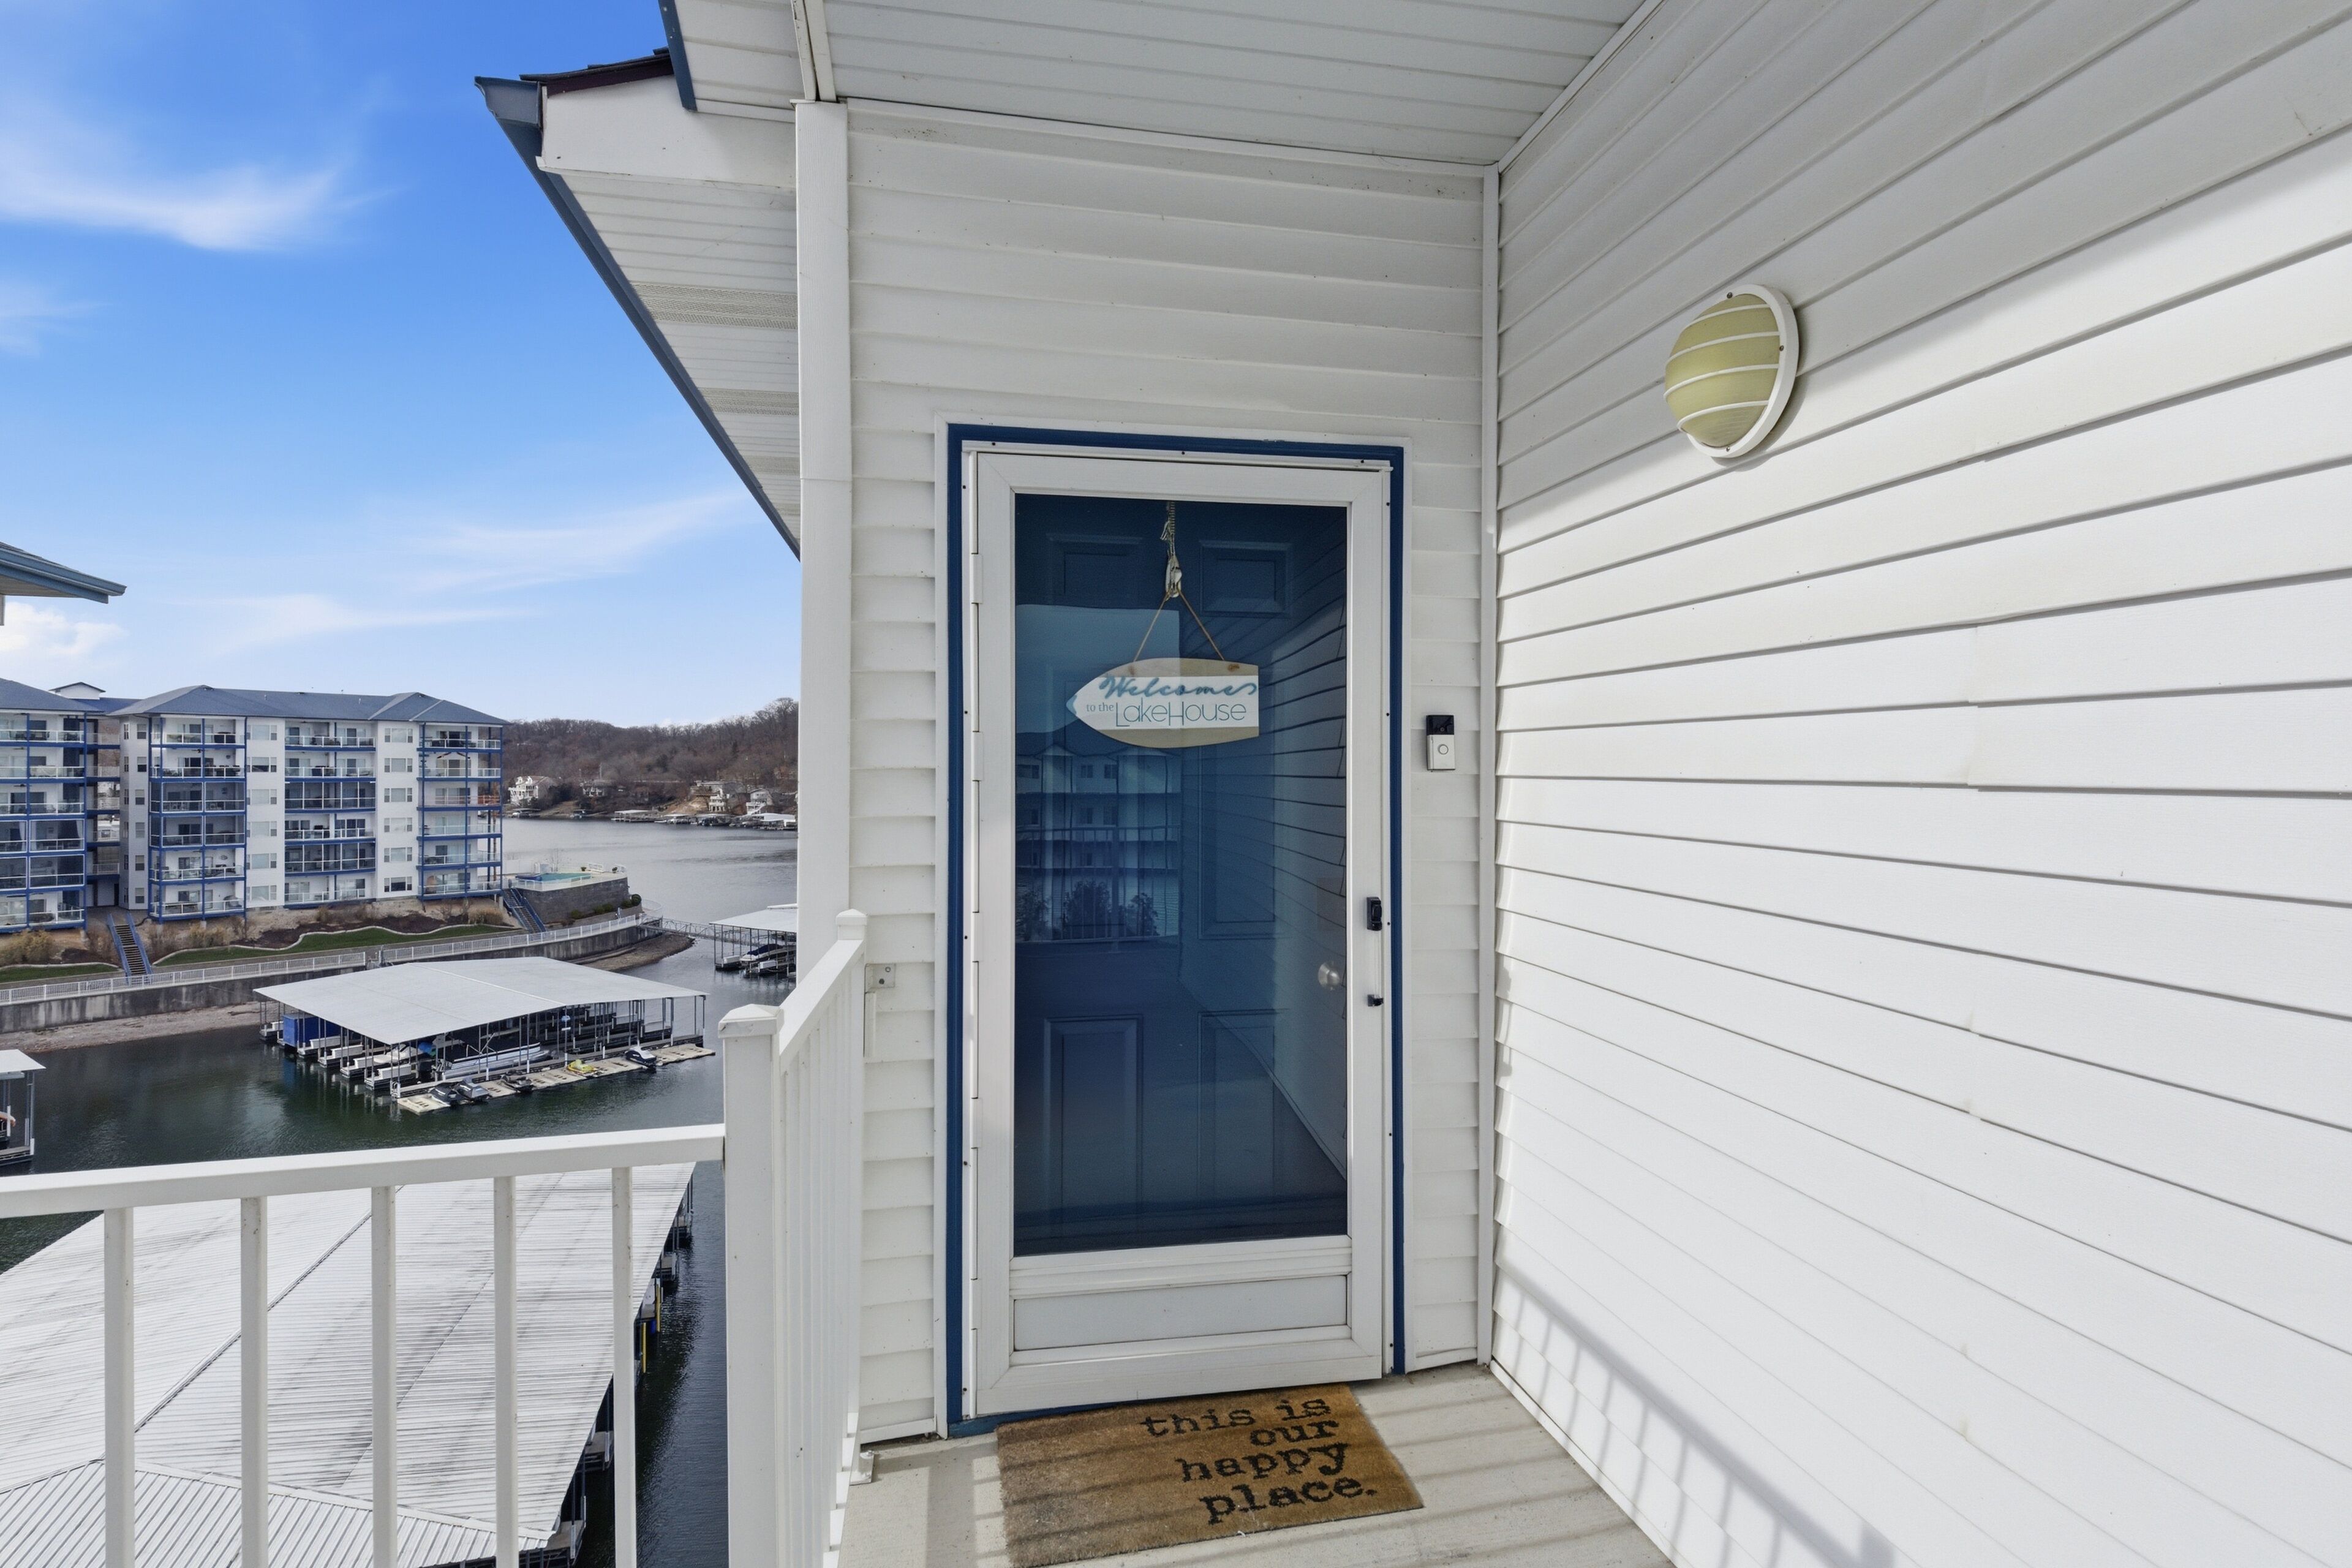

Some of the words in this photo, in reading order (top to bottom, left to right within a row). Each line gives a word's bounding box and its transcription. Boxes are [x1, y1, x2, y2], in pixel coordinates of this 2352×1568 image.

[1099, 677, 1256, 698] Welcome
[1098, 703, 1114, 712] the
[1139, 1409, 1254, 1437] this
[1275, 1398, 1331, 1420] is
[1250, 1418, 1338, 1446] our
[1175, 1442, 1351, 1482] happy
[1199, 1477, 1378, 1525] place.
